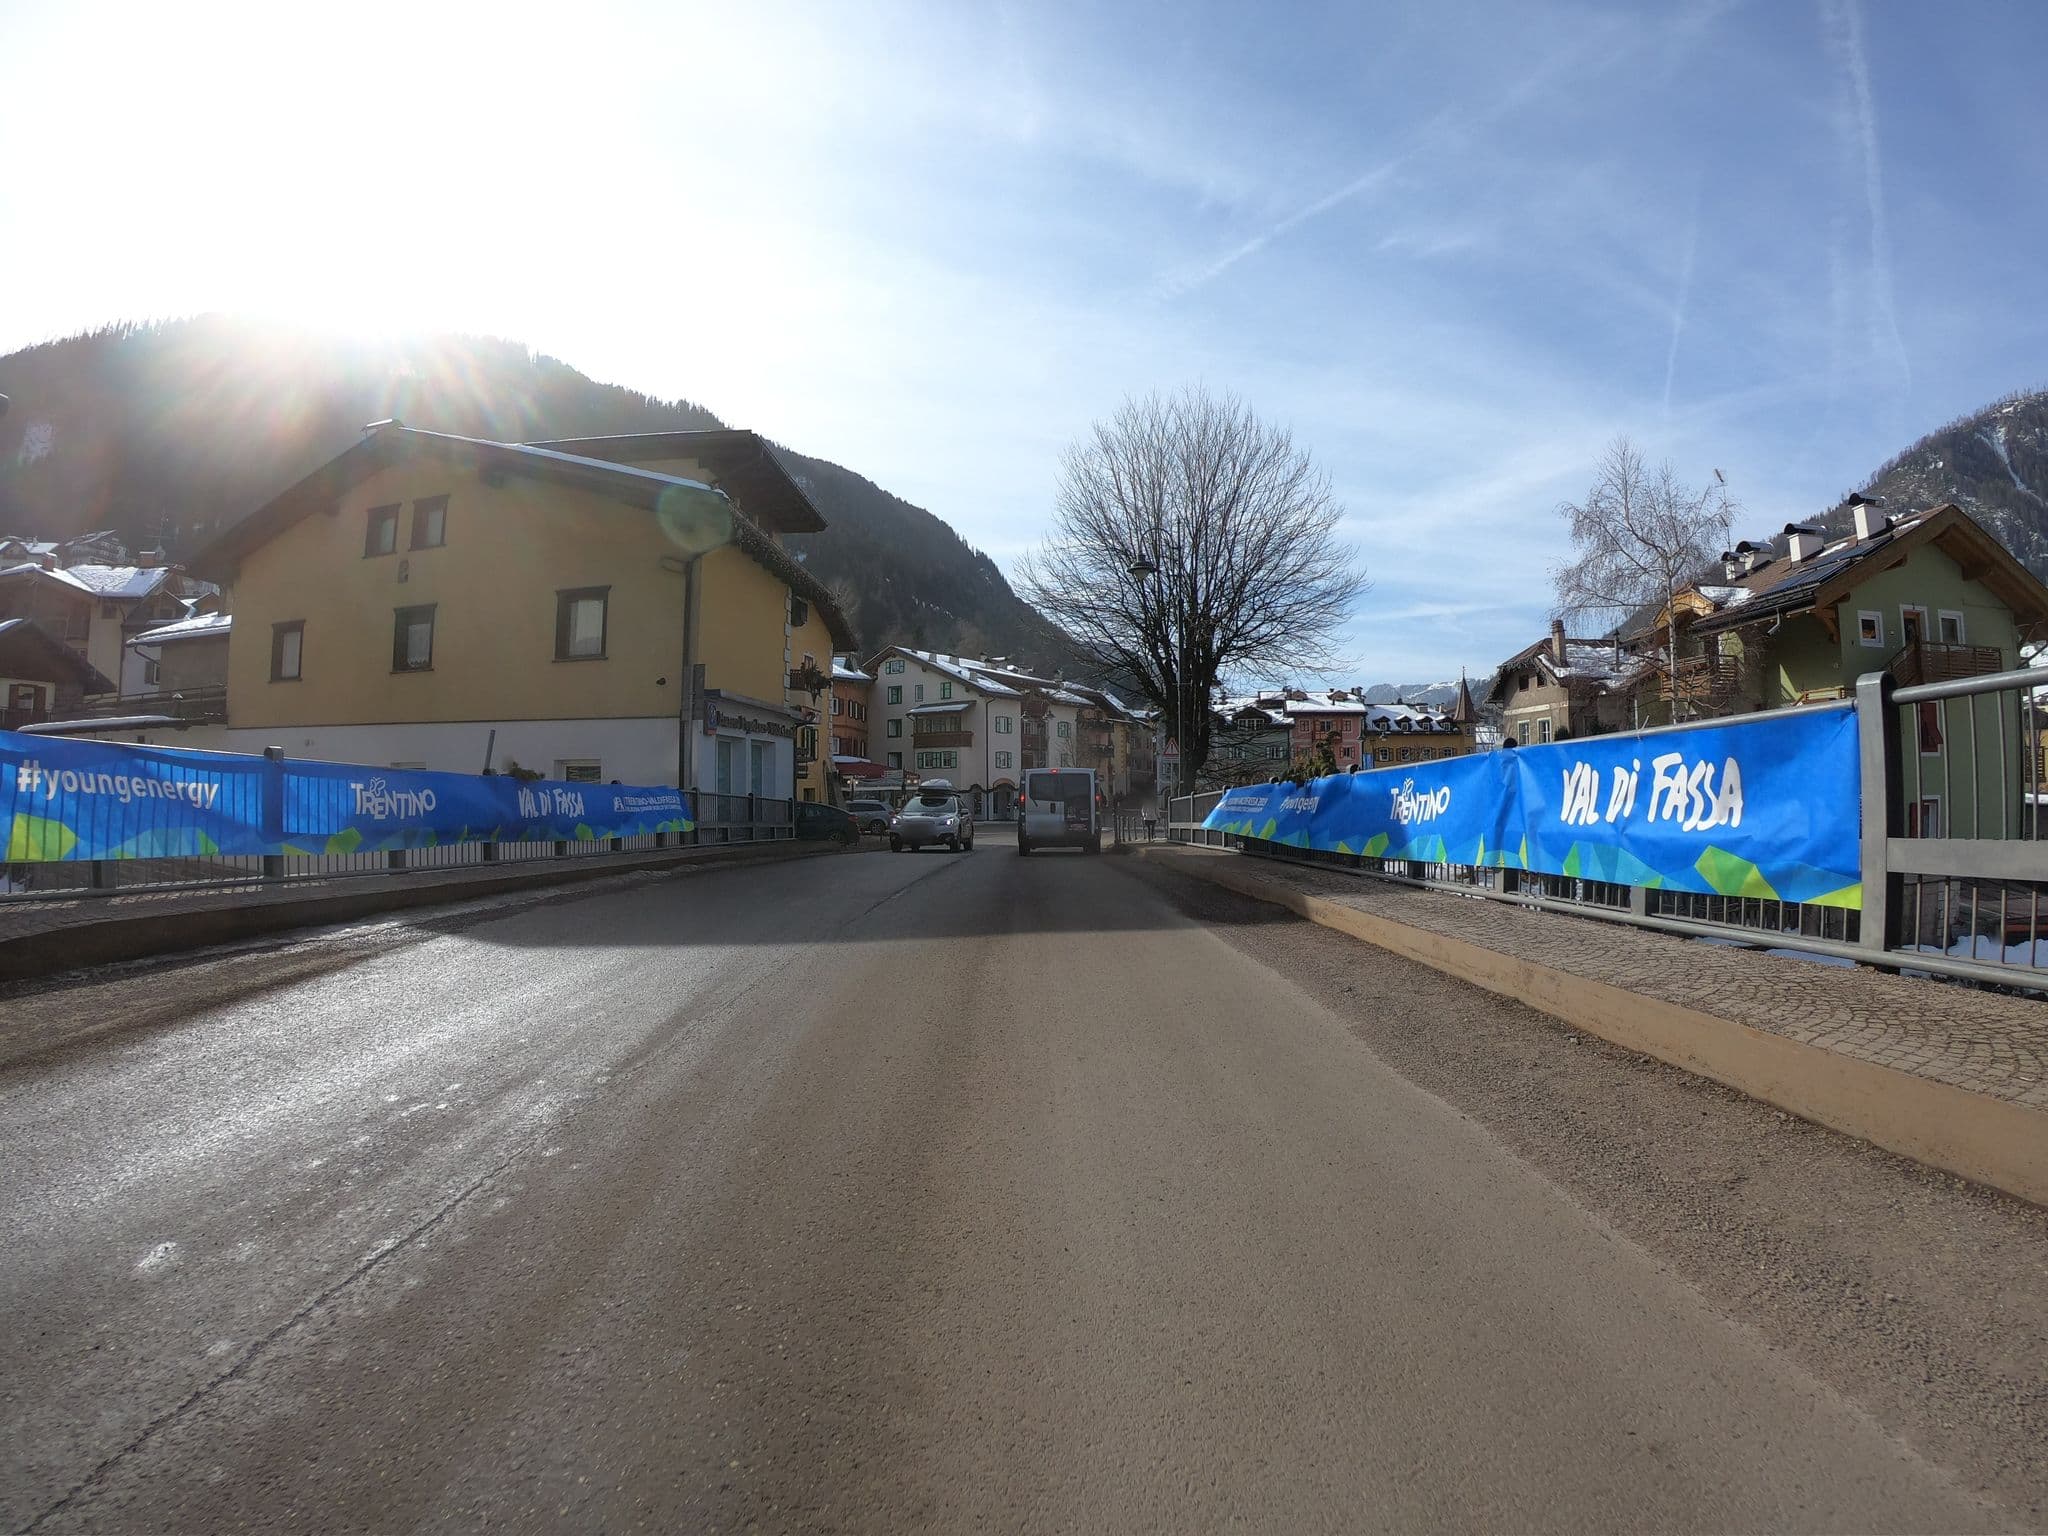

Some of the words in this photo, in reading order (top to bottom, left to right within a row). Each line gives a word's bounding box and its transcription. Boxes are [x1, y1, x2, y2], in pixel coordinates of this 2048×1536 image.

[17, 760, 218, 809] #youngenergy
[351, 782, 436, 819] TRENTINO
[518, 787, 540, 818] VAL
[556, 788, 585, 818] FASSA
[1561, 762, 1600, 825] VAL
[1647, 752, 1743, 831] FASSA
[1391, 785, 1450, 824] TRENTINO
